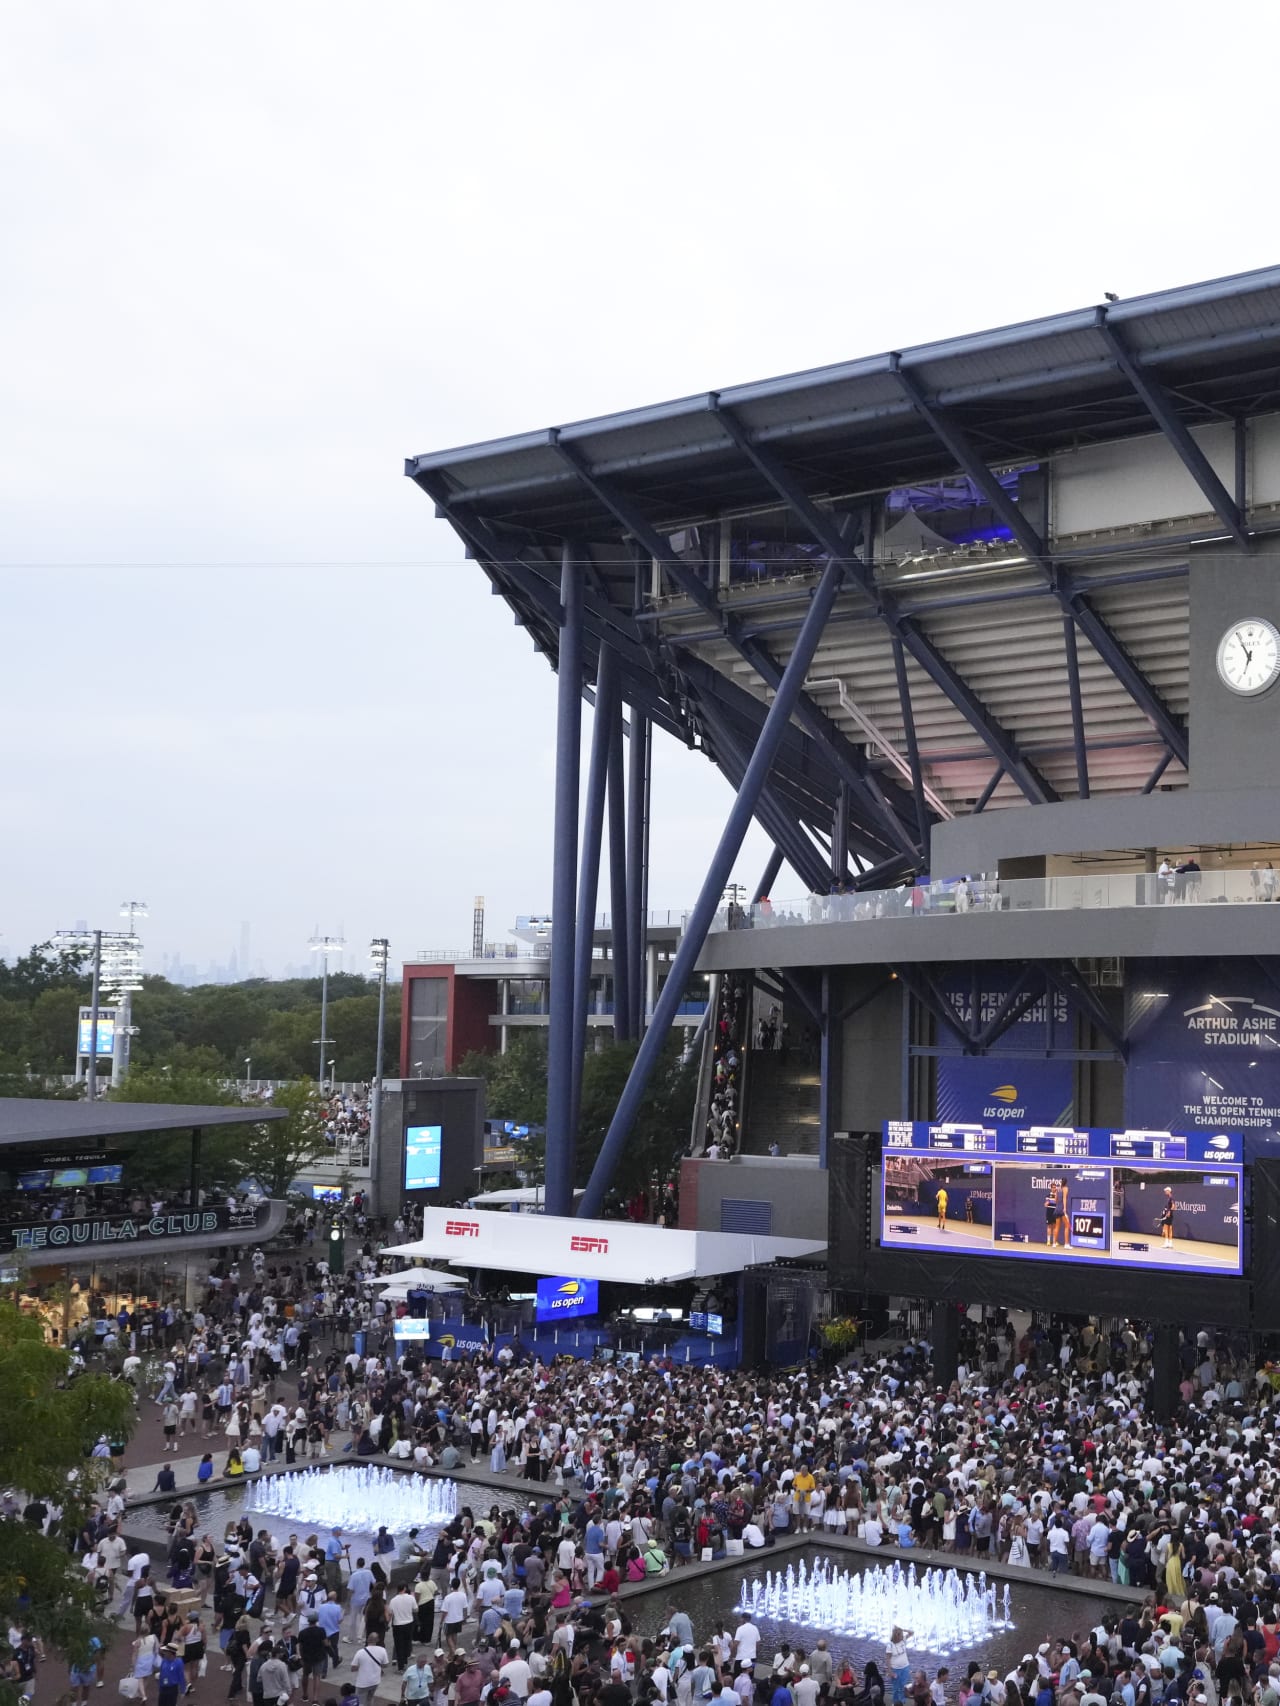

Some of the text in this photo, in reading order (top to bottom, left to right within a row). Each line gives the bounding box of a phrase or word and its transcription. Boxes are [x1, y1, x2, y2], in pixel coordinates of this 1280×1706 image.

[1187, 1017, 1277, 1030] ARTHUR ASHE
[1204, 1032, 1260, 1045] STADIUM
[1202, 1095, 1264, 1106] WELCOME TO
[983, 1106, 1025, 1120] us open
[1184, 1105, 1202, 1115] THE
[1205, 1106, 1217, 1115] US
[1220, 1106, 1246, 1116] OPEN
[1194, 1116, 1272, 1127] CHAMPIONSHIPS
[888, 1132, 913, 1147] IBM
[1204, 1150, 1235, 1161] us open
[1080, 1199, 1097, 1212] IBM
[12, 1219, 138, 1248] TEQUILA
[148, 1212, 218, 1236] CLUB
[445, 1220, 480, 1237] ESPN
[1075, 1218, 1092, 1233] 107
[570, 1235, 609, 1254] ESPN
[551, 1296, 585, 1309] us open
[456, 1339, 482, 1352] us ope
